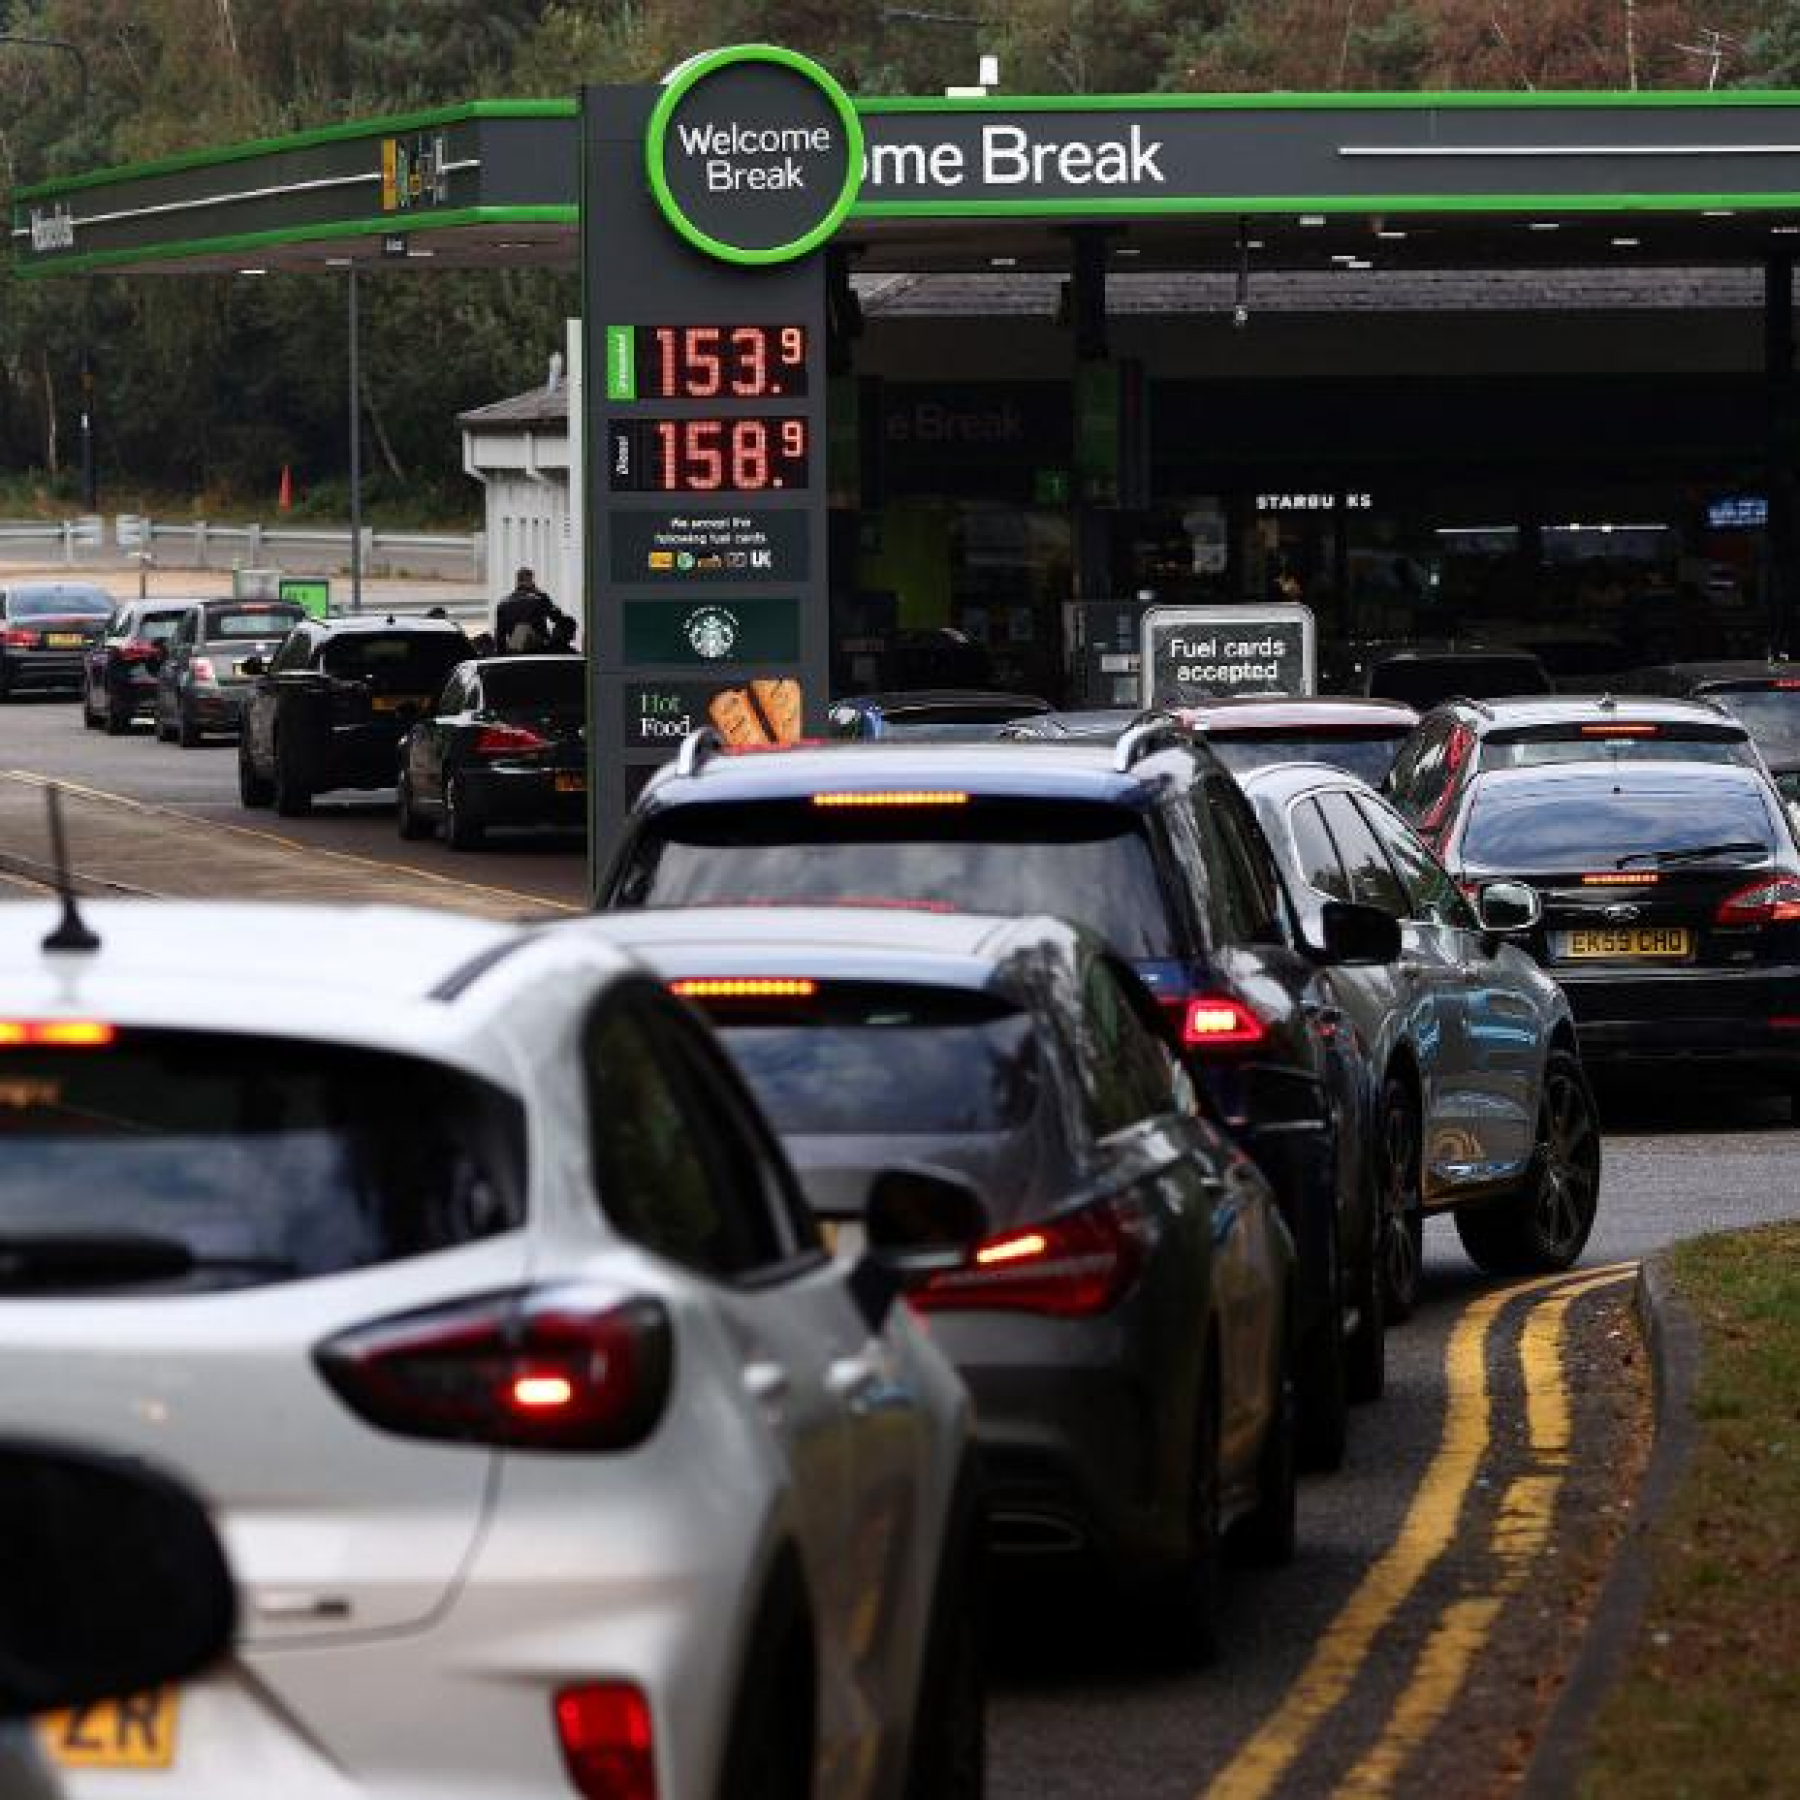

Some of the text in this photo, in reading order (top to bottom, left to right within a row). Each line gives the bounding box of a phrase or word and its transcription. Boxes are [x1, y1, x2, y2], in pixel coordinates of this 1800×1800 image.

[678, 123, 831, 155] Welcome
[863, 124, 1165, 186] me Break
[707, 158, 804, 190] Break
[1171, 636, 1286, 658] Fuel cards
[1177, 659, 1278, 684] accepted
[640, 692, 681, 713] Hot
[640, 715, 690, 737] Food
